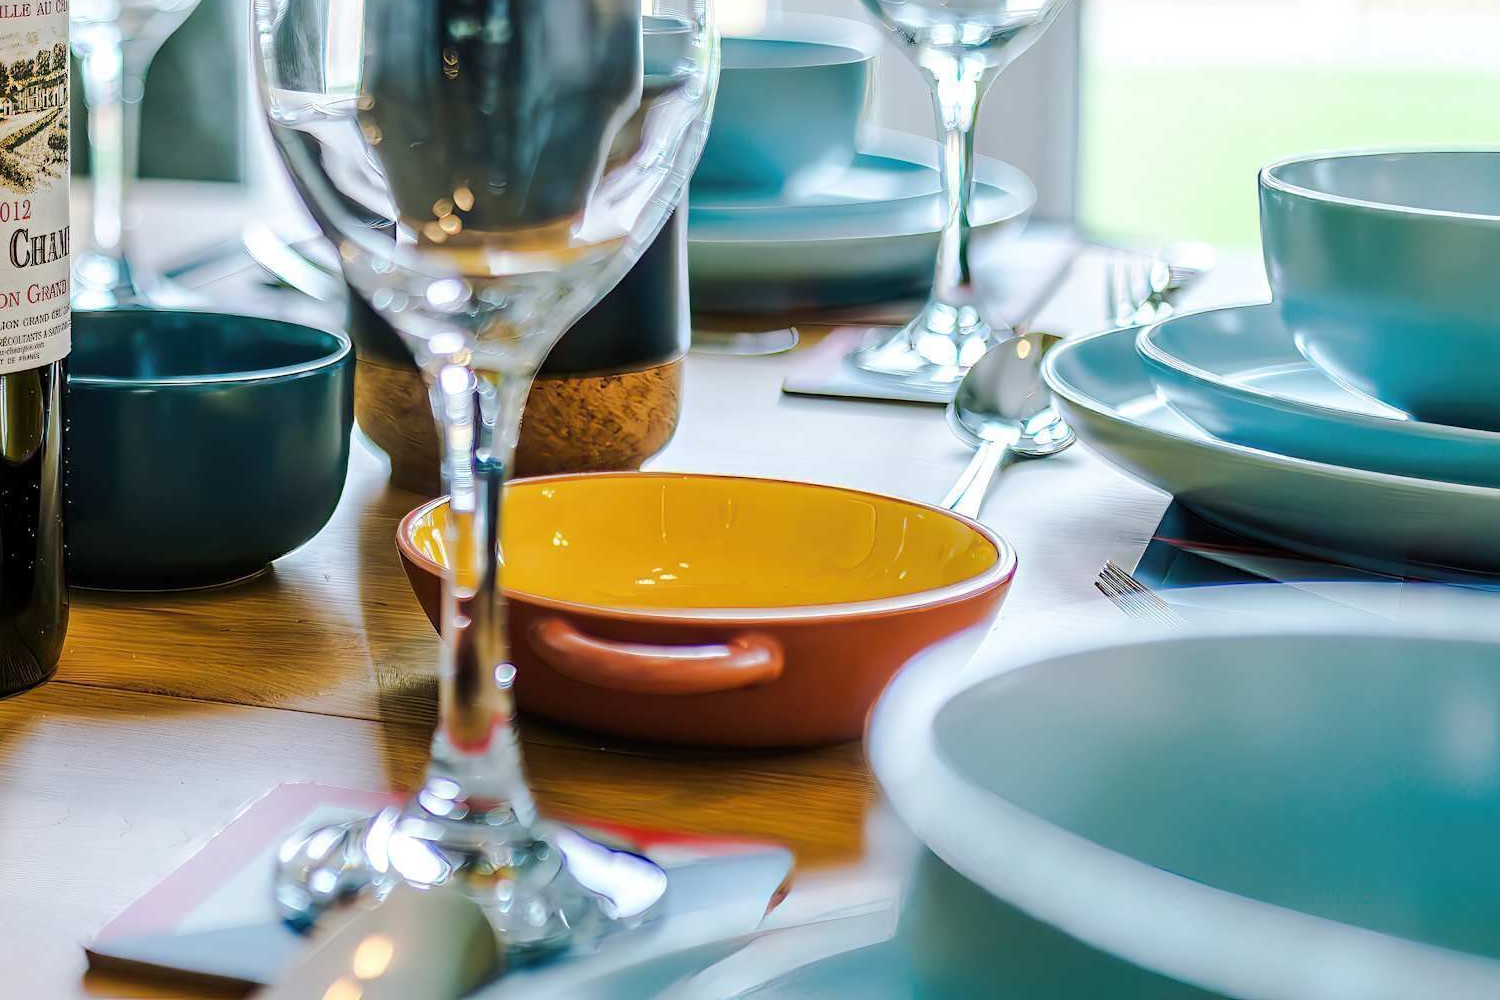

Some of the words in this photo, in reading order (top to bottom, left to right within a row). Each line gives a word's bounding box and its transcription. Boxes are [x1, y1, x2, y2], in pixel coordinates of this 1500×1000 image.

[36, 1, 52, 16] AU
[9, 225, 70, 268] CHAM
[27, 279, 67, 304] GRAND
[22, 313, 50, 327] GRAND
